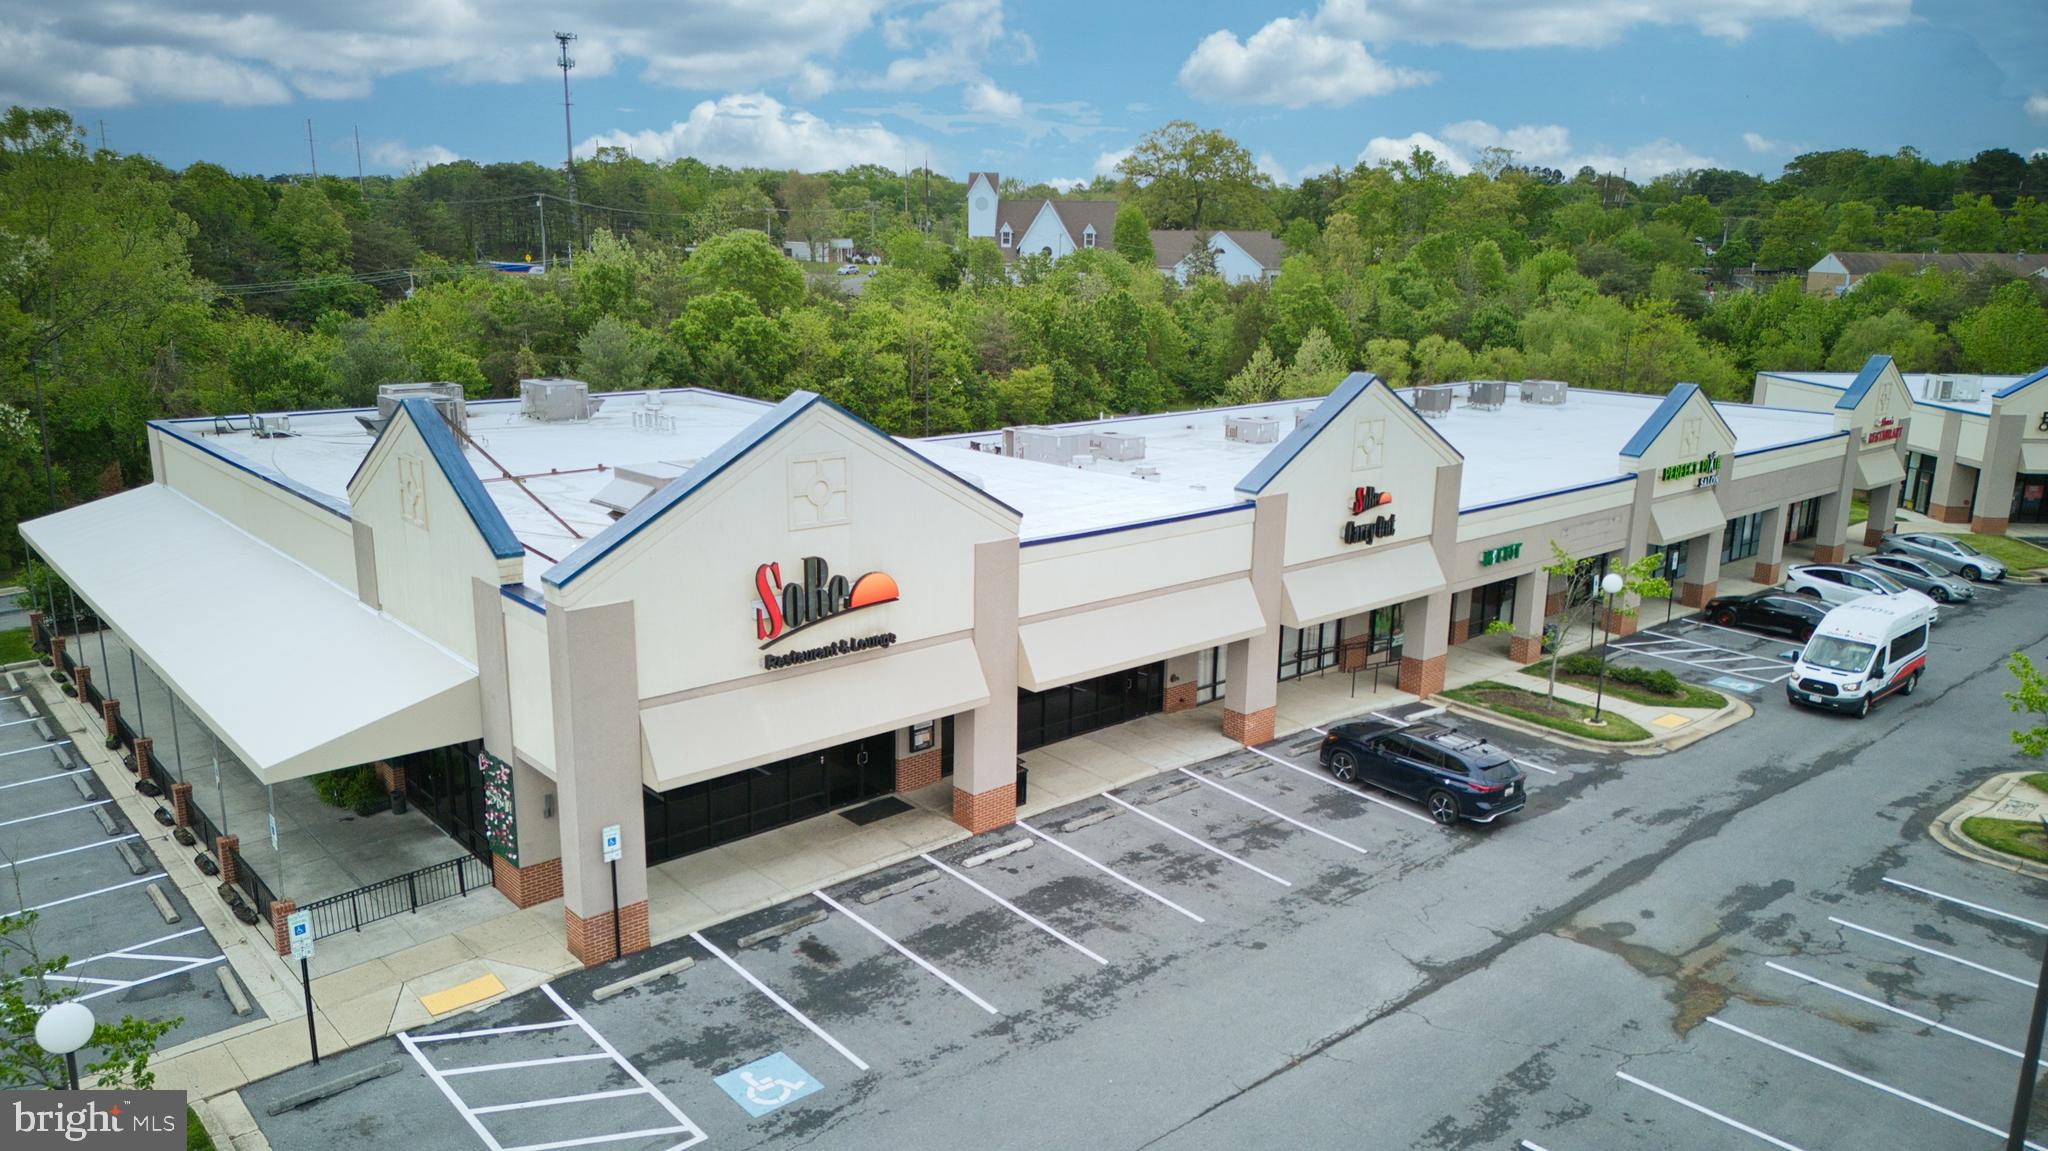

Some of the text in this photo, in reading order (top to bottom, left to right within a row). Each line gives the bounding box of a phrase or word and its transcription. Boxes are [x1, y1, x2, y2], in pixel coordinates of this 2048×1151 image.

[1662, 460, 1698, 481] PERFECT
[1344, 514, 1395, 545] Carry Out
[765, 632, 897, 670] Restaurant & Lounge
